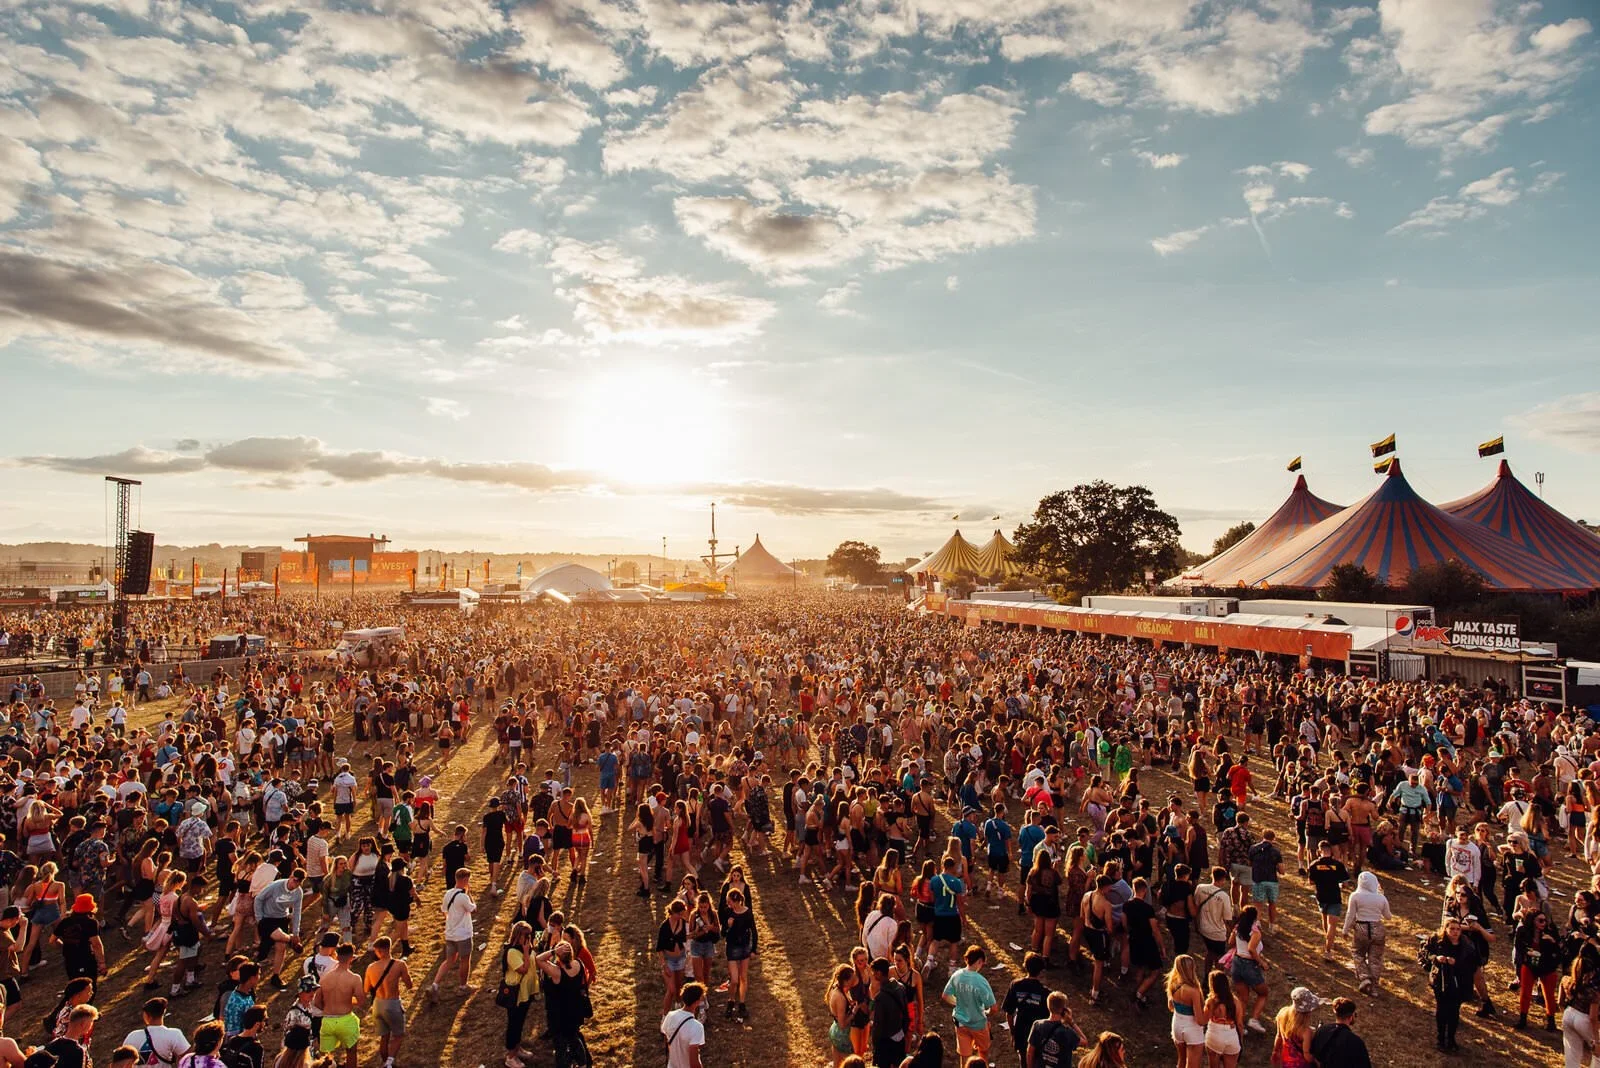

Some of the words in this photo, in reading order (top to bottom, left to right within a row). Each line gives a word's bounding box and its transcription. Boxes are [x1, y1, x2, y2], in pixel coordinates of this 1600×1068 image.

[383, 561, 406, 570] WEST
[1143, 622, 1174, 635] READING
[1194, 627, 1209, 639] BAR
[1454, 621, 1480, 633] MAX
[1482, 623, 1517, 634] TASTE
[1452, 634, 1494, 646] DRINKS
[1495, 637, 1520, 648] BAR
